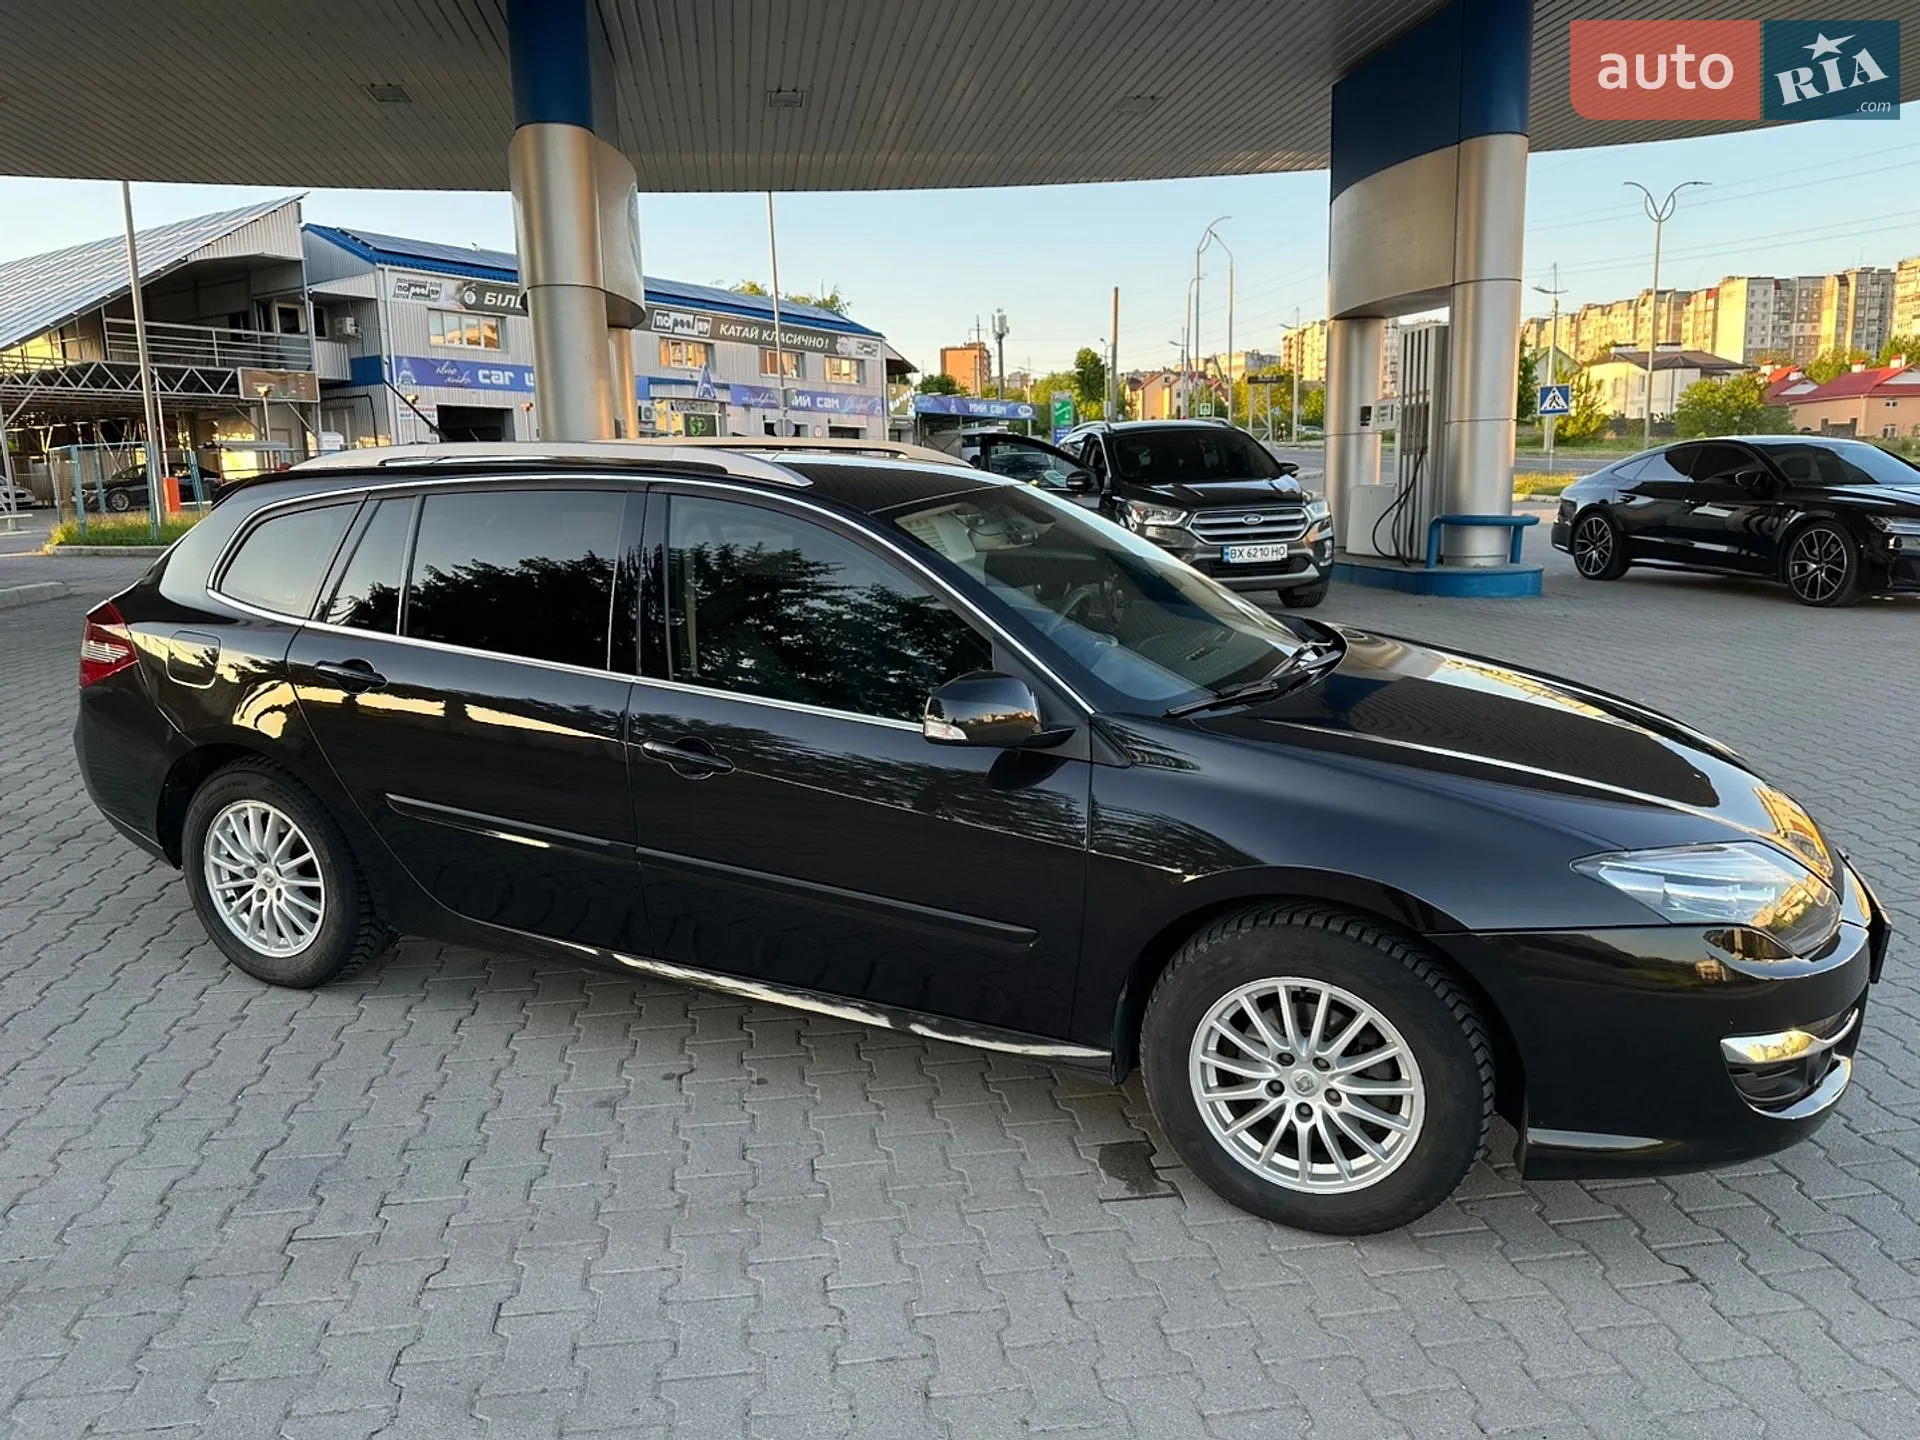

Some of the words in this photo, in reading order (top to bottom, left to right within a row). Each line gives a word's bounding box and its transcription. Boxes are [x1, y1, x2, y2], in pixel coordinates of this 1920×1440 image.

[719, 323, 759, 339] КАТАЙ
[762, 329, 830, 349] КЛАСИЧНО!
[478, 369, 514, 386] car
[1231, 549, 1244, 559] BX
[1246, 547, 1270, 558] 6210
[1271, 546, 1286, 556] HO
